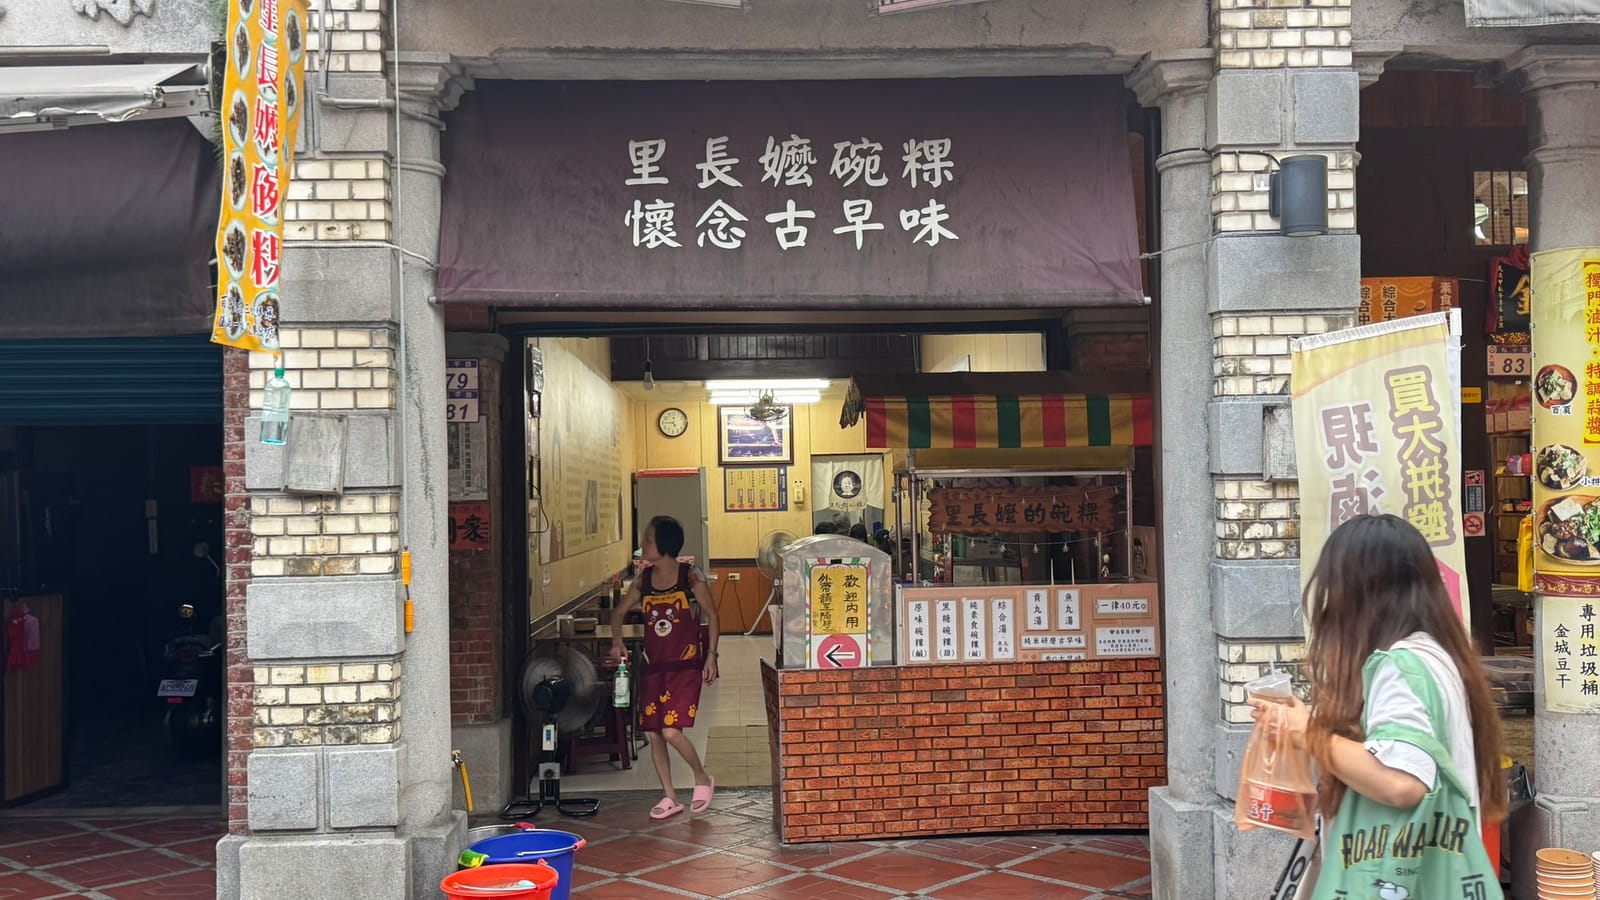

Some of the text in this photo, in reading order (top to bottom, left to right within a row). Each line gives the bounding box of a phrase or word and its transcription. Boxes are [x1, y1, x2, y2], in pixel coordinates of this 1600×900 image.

[625, 134, 955, 189] 里長嬤碗粿
[624, 198, 960, 251] 懷念古早味
[446, 373, 468, 389] 79
[1502, 358, 1525, 374] 83
[447, 403, 469, 420] 81
[945, 502, 1100, 526] 里長嬤的碗粿
[842, 574, 862, 629] 歡迎內用
[1033, 592, 1042, 625] 貢丸湯
[1064, 592, 1074, 626] 魚丸湯
[1554, 623, 1572, 688] 金城豆干
[1579, 603, 1599, 696] 專用垃圾桶
[1340, 824, 1391, 870] ROAD
[1461, 880, 1487, 900] 50
